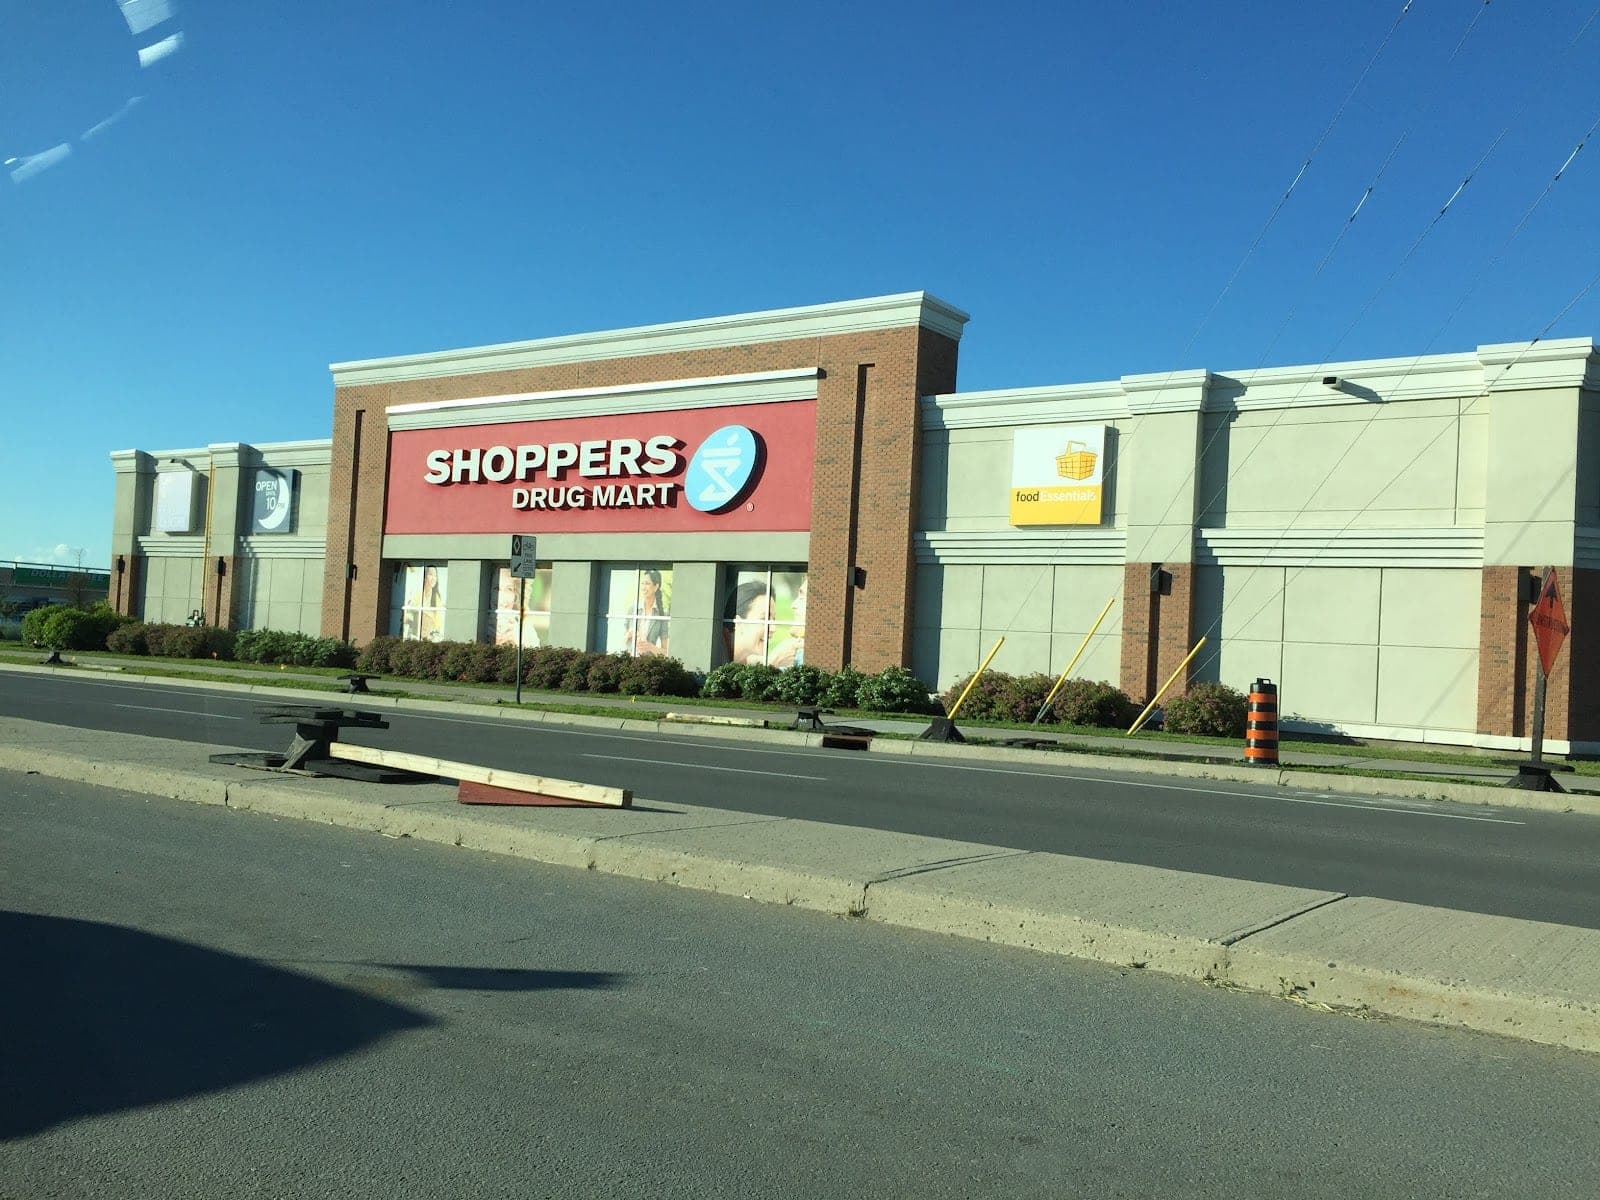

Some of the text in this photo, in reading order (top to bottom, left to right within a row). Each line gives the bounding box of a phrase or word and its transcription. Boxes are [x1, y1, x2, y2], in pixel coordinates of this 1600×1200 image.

[424, 435, 677, 484] SHOPPERS
[255, 480, 277, 491] OPEN
[511, 482, 674, 509] DRUG MART
[266, 496, 276, 510] 10
